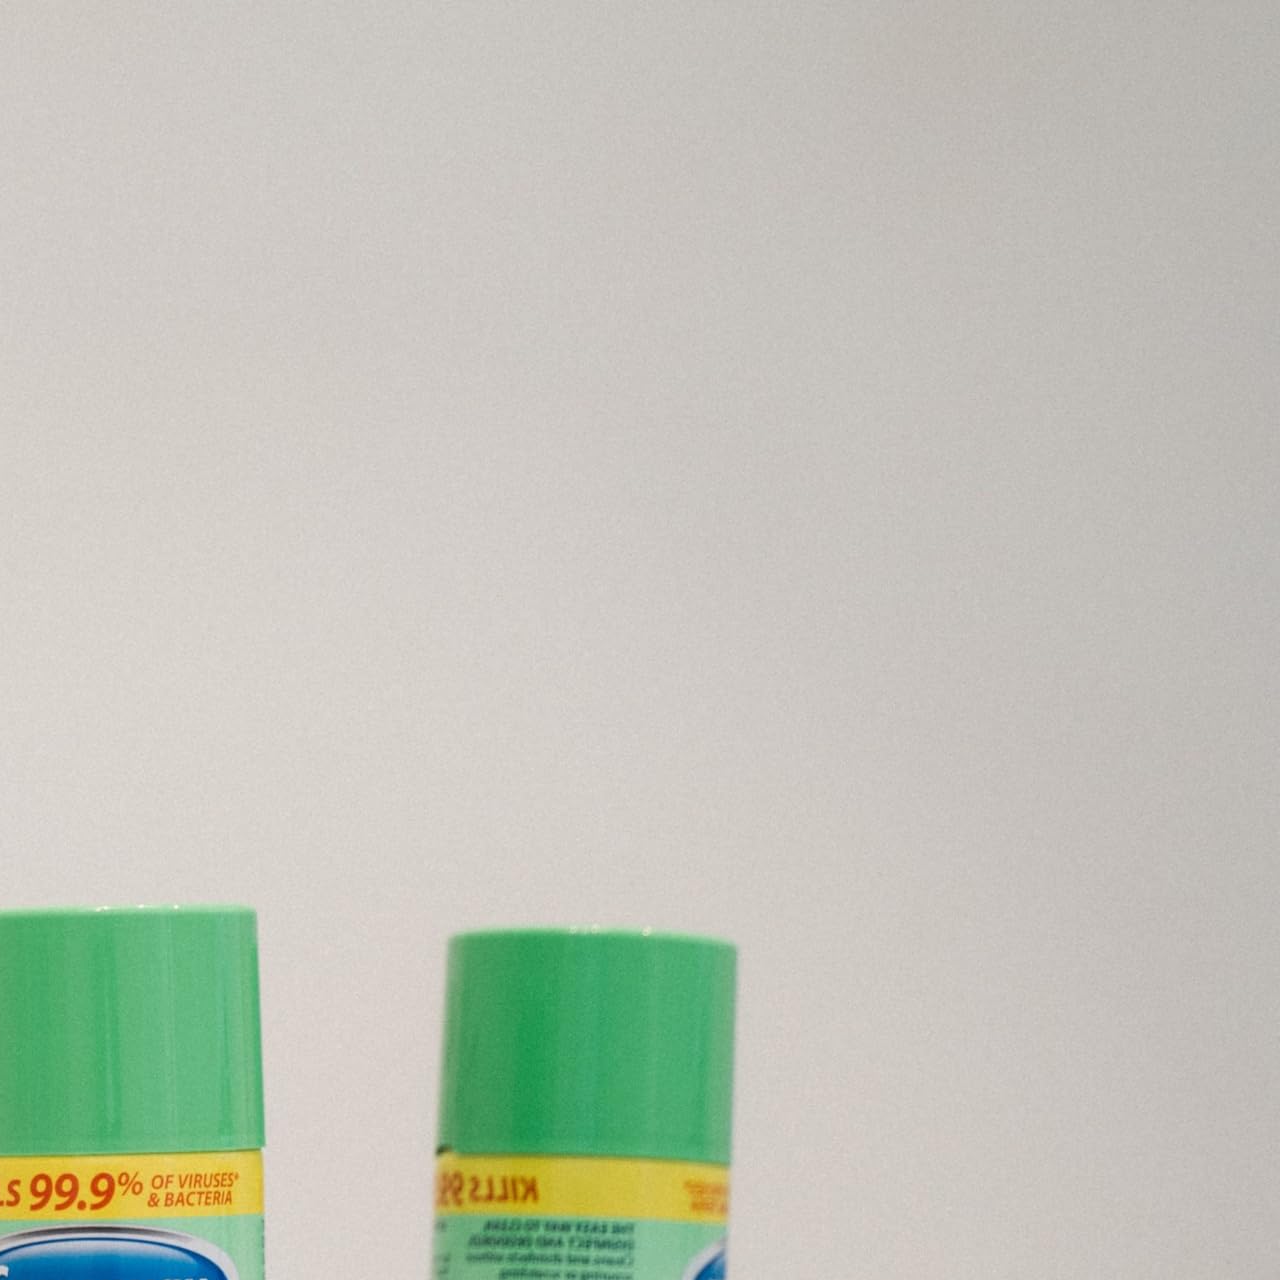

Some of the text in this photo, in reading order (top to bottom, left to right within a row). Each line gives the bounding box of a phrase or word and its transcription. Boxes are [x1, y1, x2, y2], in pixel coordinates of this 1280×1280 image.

[151, 1174, 174, 1190] OF
[29, 1172, 144, 1211] 99.9%
[147, 1190, 232, 1208] & BACTERIA
